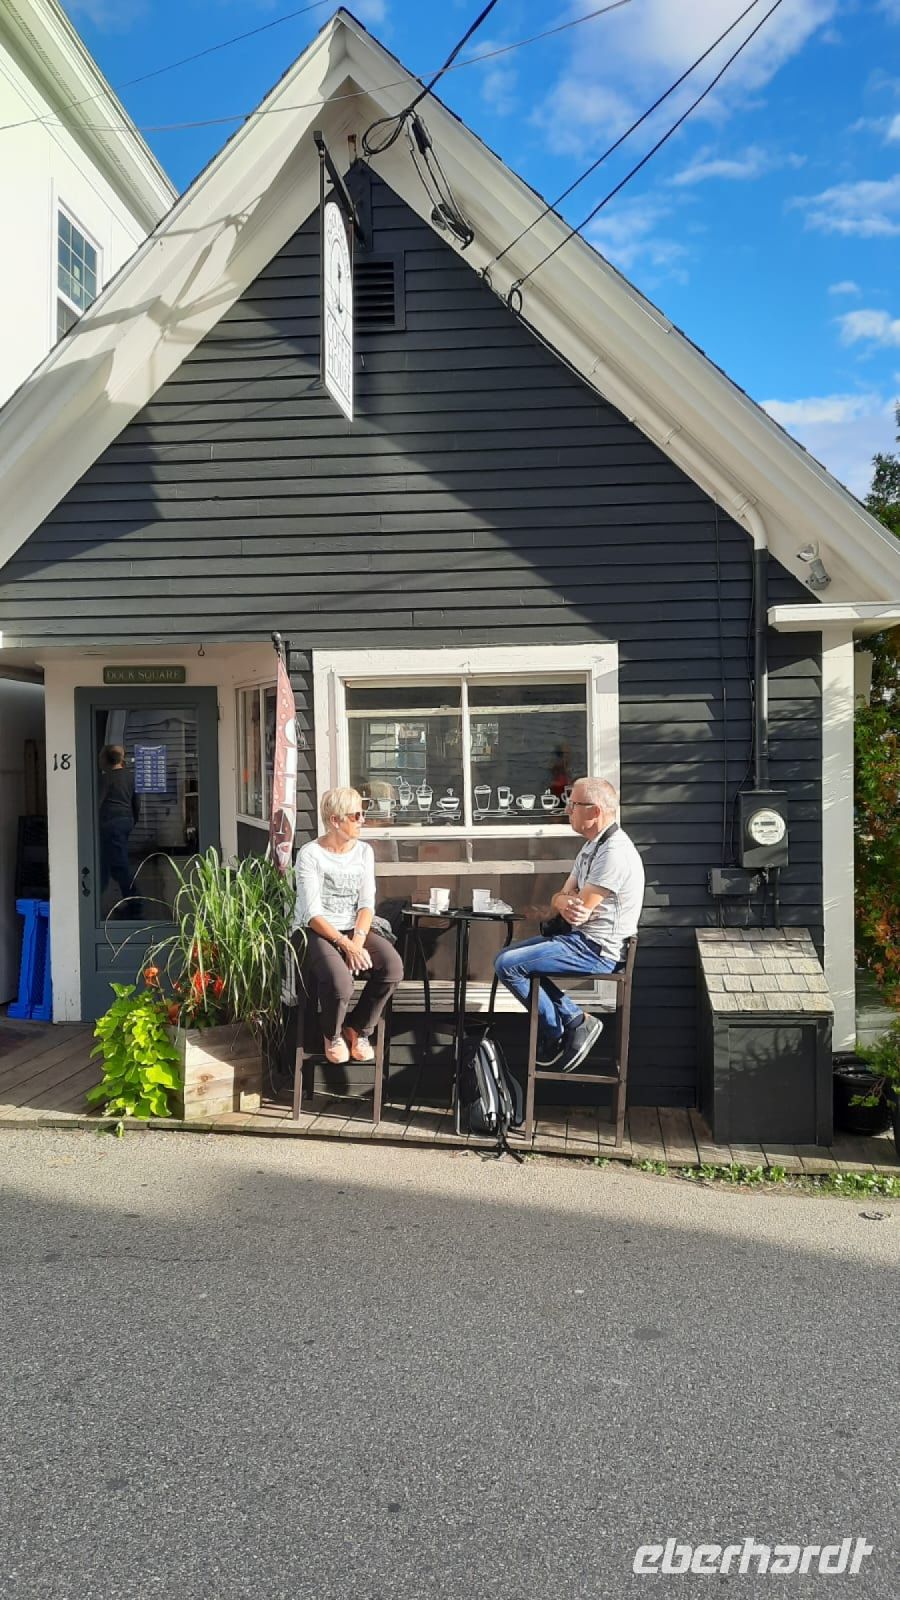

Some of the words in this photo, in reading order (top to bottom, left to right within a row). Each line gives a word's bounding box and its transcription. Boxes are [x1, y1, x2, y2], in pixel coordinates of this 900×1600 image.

[106, 671, 135, 681] DOCK
[138, 670, 179, 682] SQUARE
[53, 753, 72, 771] 18
